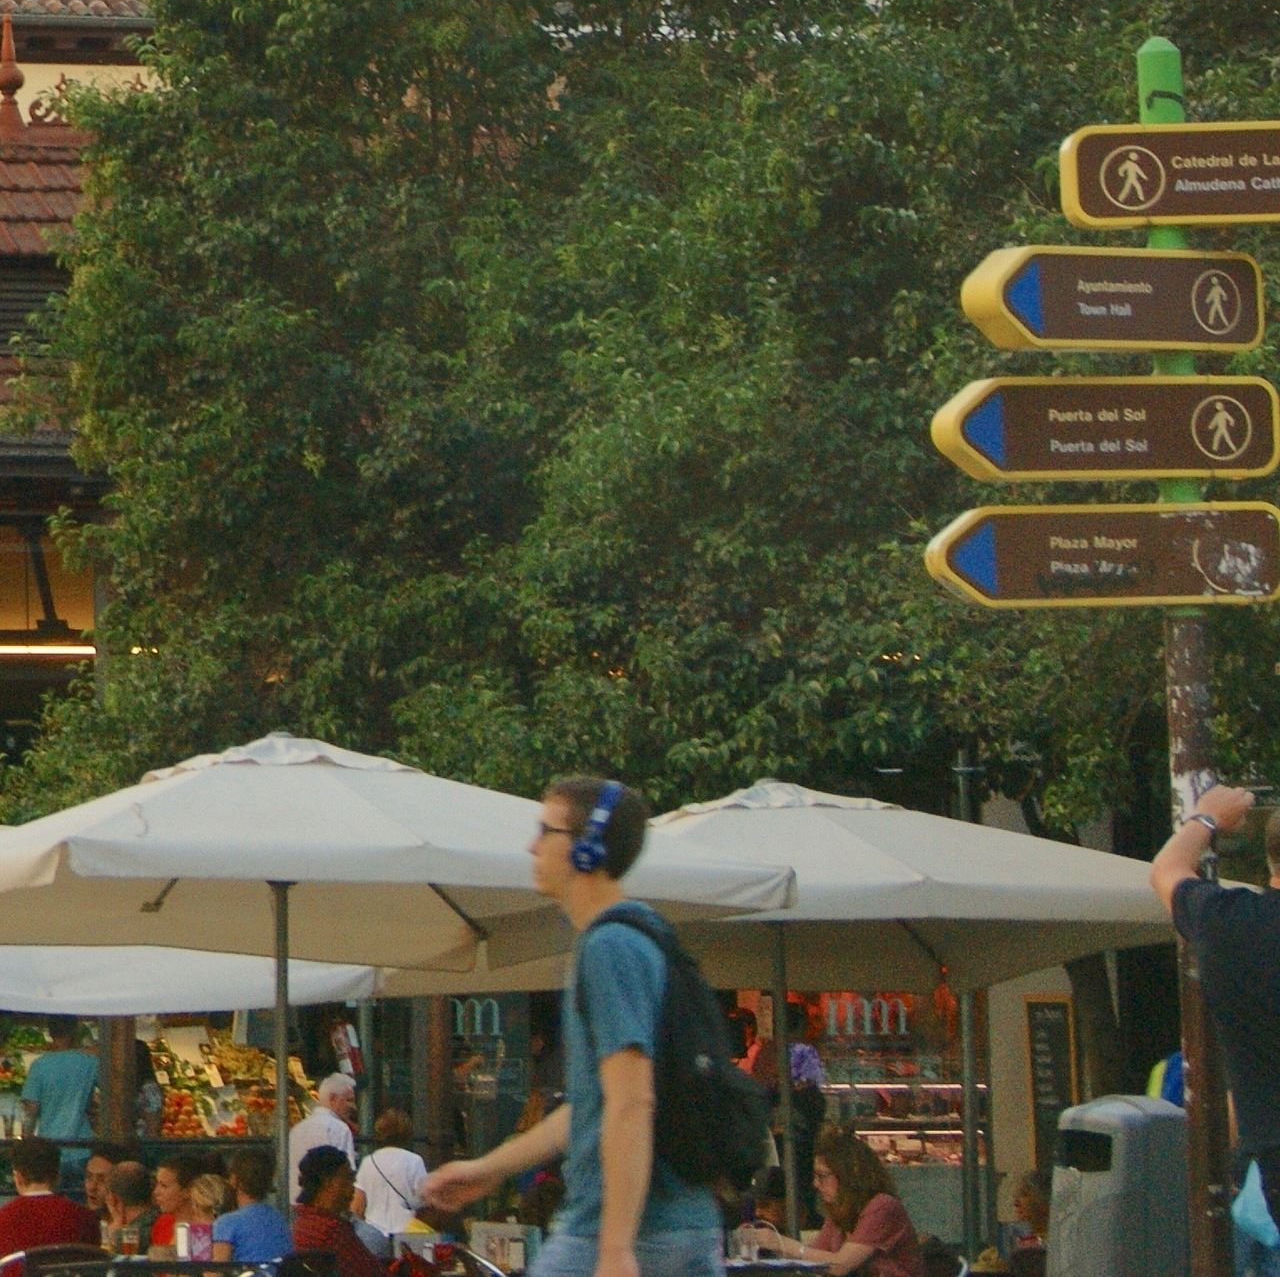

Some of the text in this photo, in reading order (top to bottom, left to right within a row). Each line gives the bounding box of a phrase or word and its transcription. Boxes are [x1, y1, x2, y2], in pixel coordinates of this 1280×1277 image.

[1171, 153, 1280, 169] Catedral de La
[1174, 178, 1247, 192] Almudena
[1077, 279, 1153, 295] Ayuntamiento
[1078, 302, 1133, 316] Town Hall
[1048, 408, 1147, 422] Puerta del Sol
[1050, 438, 1148, 453] Puerta del Sol
[1050, 536, 1138, 552] Plaza Mayor
[1050, 561, 1090, 575] Plaza
